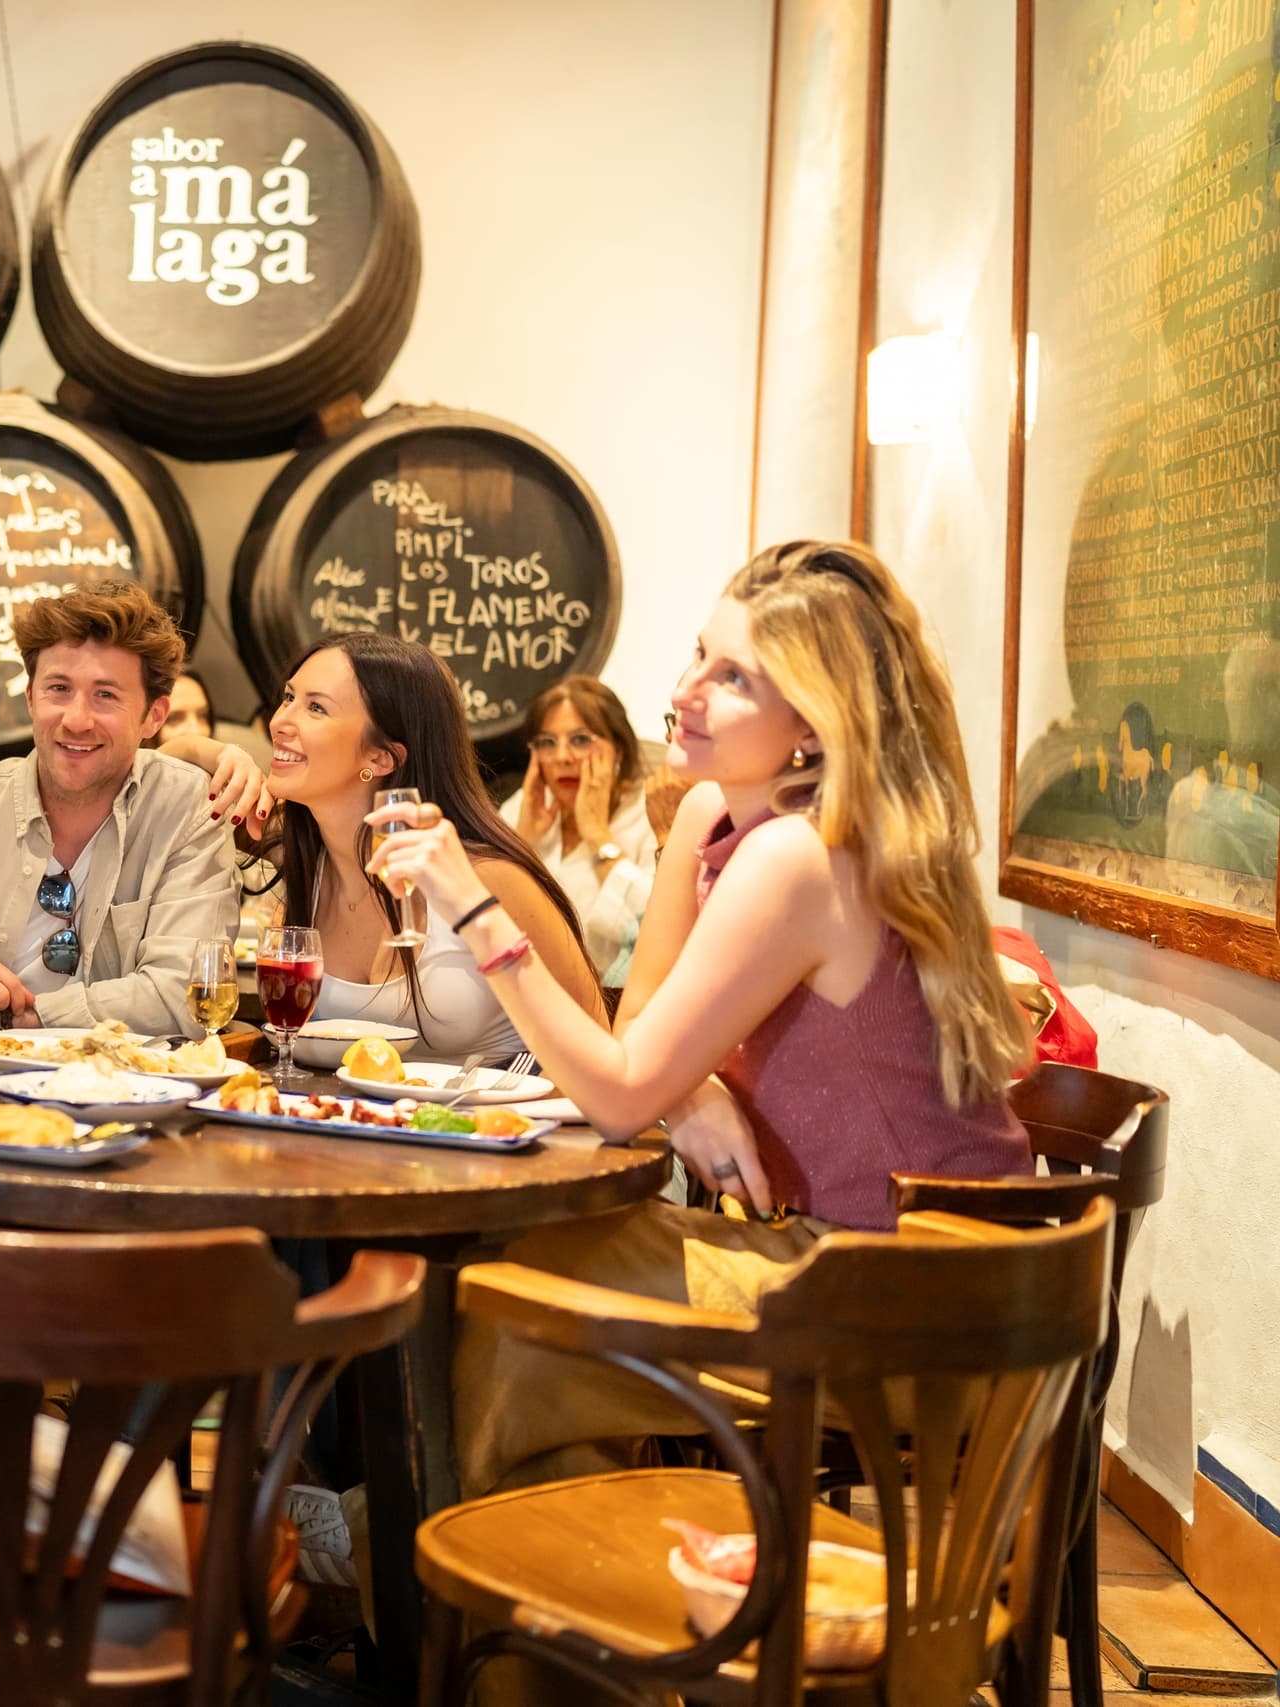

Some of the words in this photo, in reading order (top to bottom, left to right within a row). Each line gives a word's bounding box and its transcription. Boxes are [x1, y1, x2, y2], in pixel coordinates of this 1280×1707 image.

[130, 127, 224, 163] sabor
[1095, 130, 1209, 228] PROGRAMA
[129, 203, 315, 307] laga
[1119, 227, 1192, 302] CORRIDAS
[1206, 185, 1264, 256] TOROS
[1184, 273, 1251, 322] MATADORES
[1188, 324, 1280, 390] BELMONT
[1223, 361, 1280, 412] CAMAR
[1197, 436, 1280, 488] BELMONT
[401, 559, 449, 584] LOS
[462, 551, 551, 591] TOROS
[1178, 560, 1247, 590] GUERRITA
[428, 626, 478, 657] EL
[482, 627, 577, 673] AMOR
